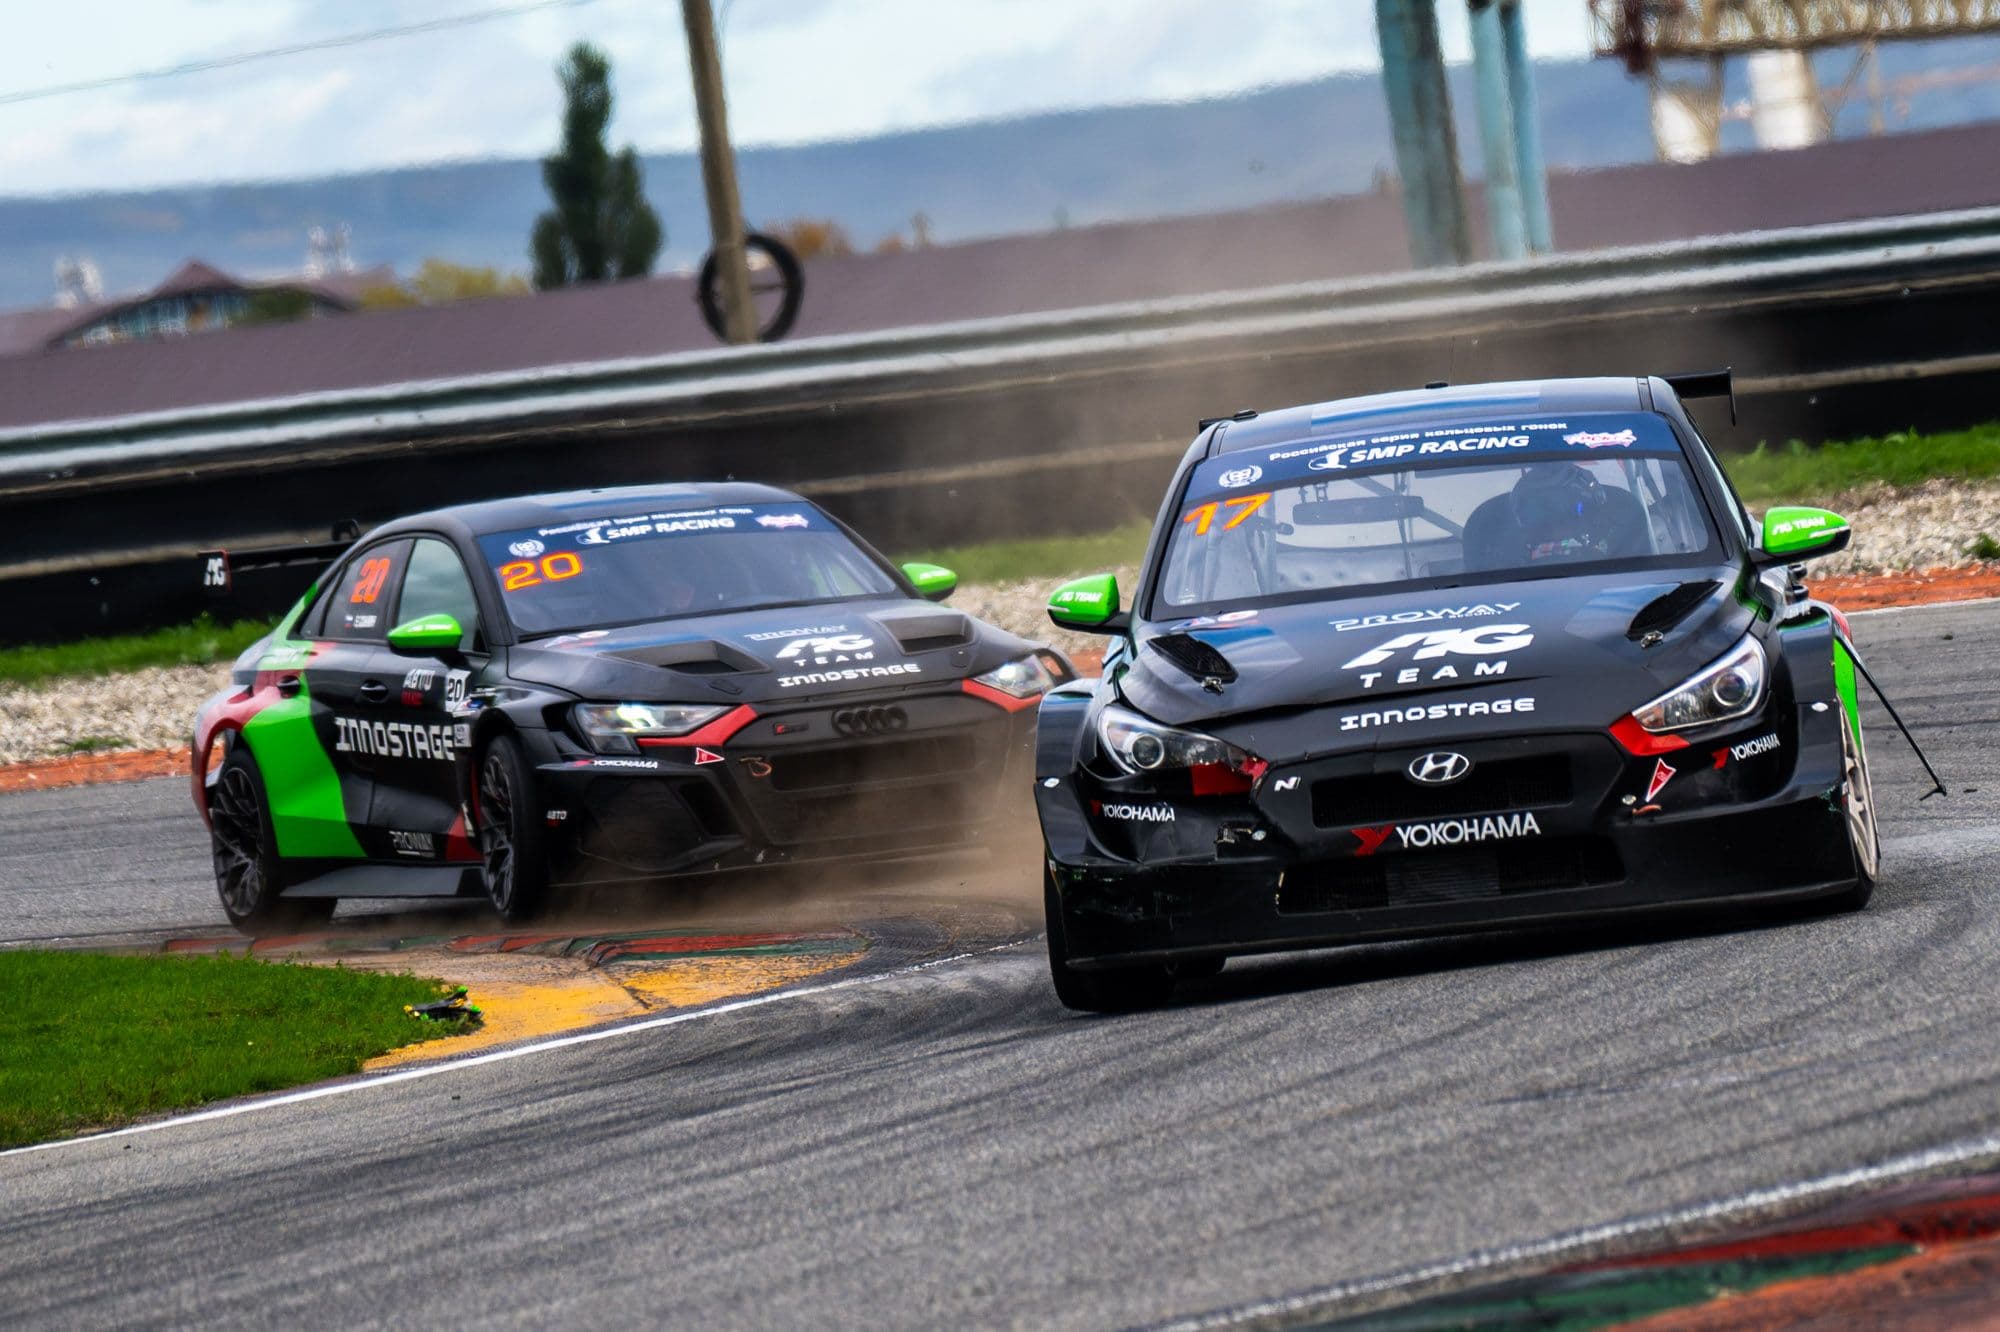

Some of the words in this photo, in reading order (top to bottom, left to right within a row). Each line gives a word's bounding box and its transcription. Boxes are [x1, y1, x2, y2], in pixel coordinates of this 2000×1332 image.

[1349, 440, 1415, 463] SMP
[1419, 435, 1530, 453] RACING
[1183, 492, 1273, 536] 17
[607, 525, 652, 539] SMP
[655, 518, 735, 533] RACING
[351, 558, 390, 603] 20
[499, 552, 583, 592] 20
[794, 651, 874, 667] TEAM
[777, 663, 922, 688] INNOSTAGE
[1360, 661, 1507, 688] TEAM
[447, 678, 462, 703] 20
[1340, 698, 1535, 731] INNOSTAGE
[334, 717, 455, 762] INNOSTAGE
[1730, 732, 1781, 761] YOKOHAMA
[593, 759, 658, 770] YOKOHAMA
[1102, 802, 1176, 822] YOKOHAMA
[1396, 811, 1542, 849] YOKOHAMA
